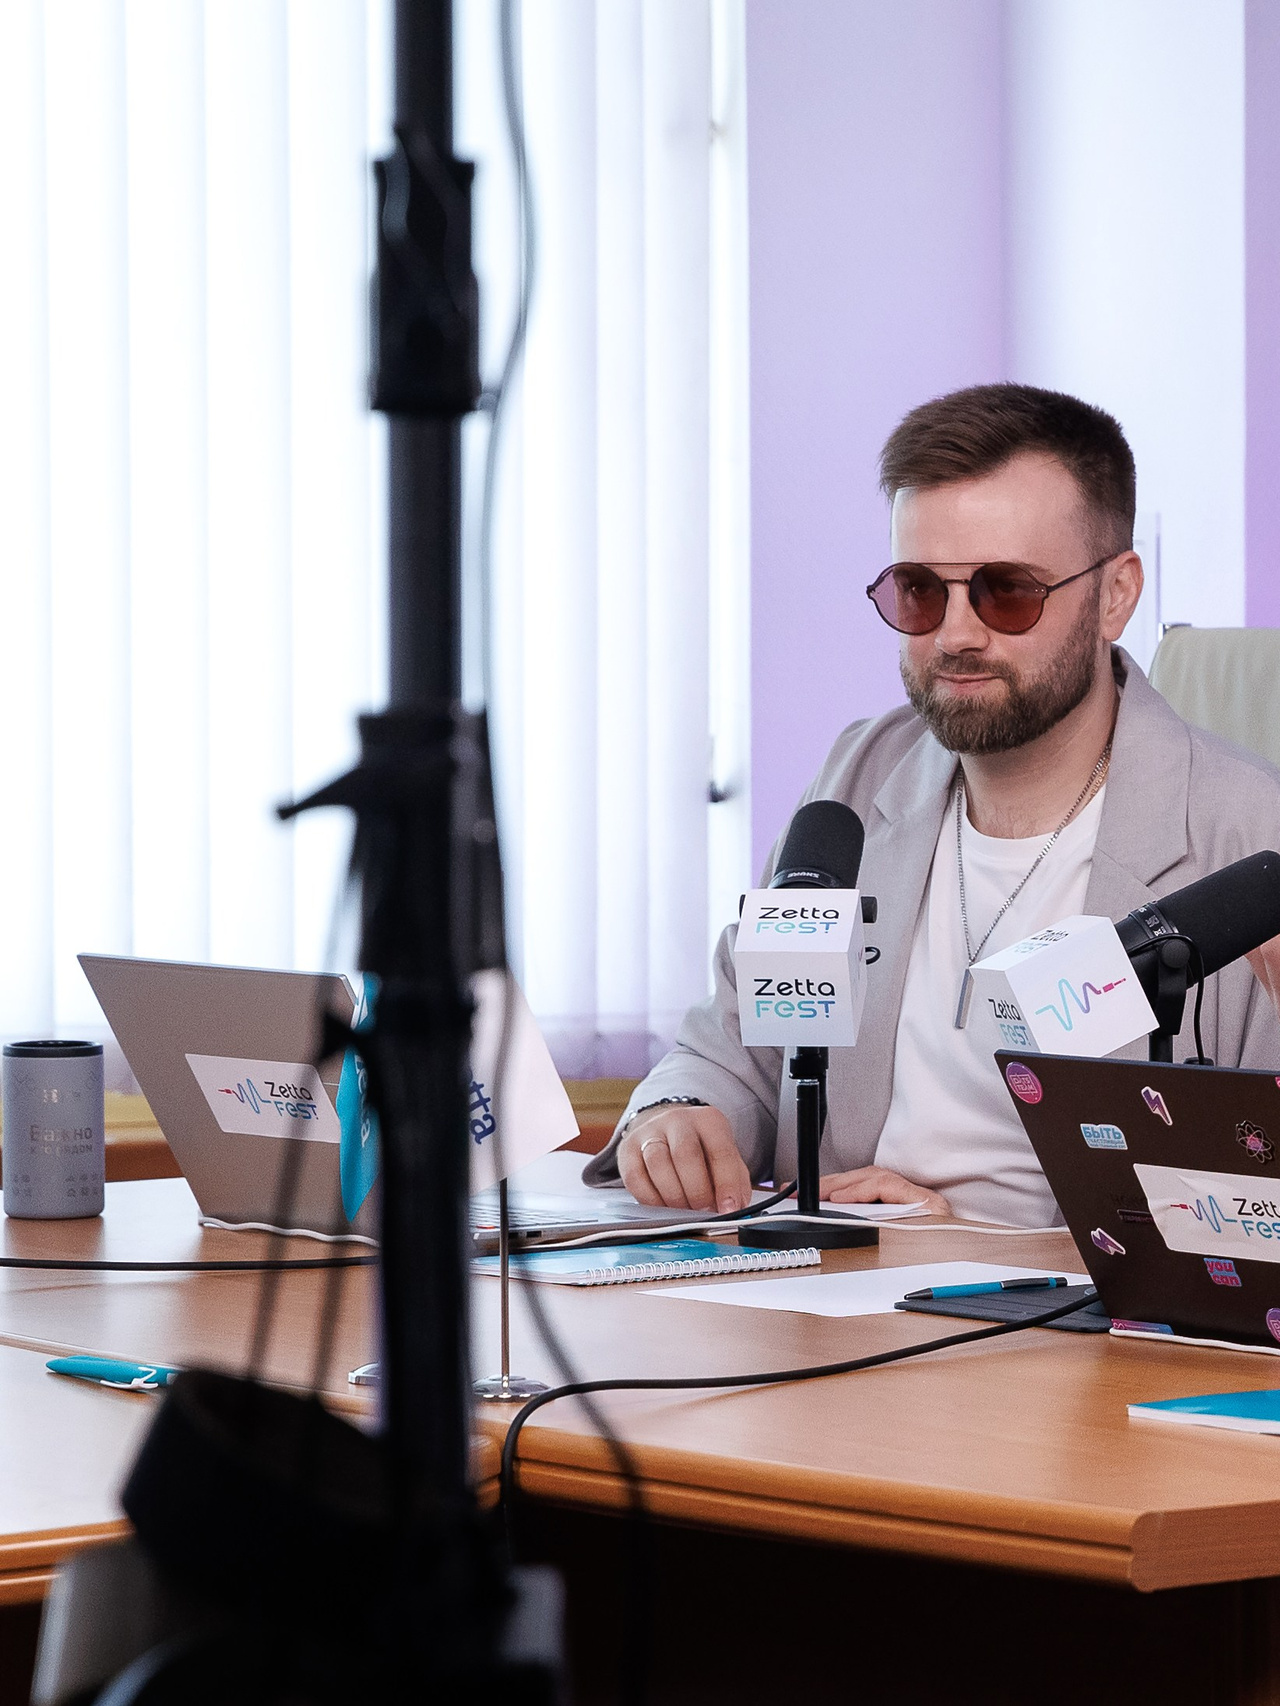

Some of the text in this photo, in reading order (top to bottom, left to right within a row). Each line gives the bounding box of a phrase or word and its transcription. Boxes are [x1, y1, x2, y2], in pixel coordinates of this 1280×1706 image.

[758, 907, 840, 919] Zetta
[753, 978, 836, 997] Zetta
[988, 998, 1022, 1021] Zetta
[264, 1081, 313, 1101] Zetta
[1082, 1126, 1122, 1140] БЫТЬ
[1205, 1260, 1235, 1273] you
[1212, 1274, 1241, 1286] can
